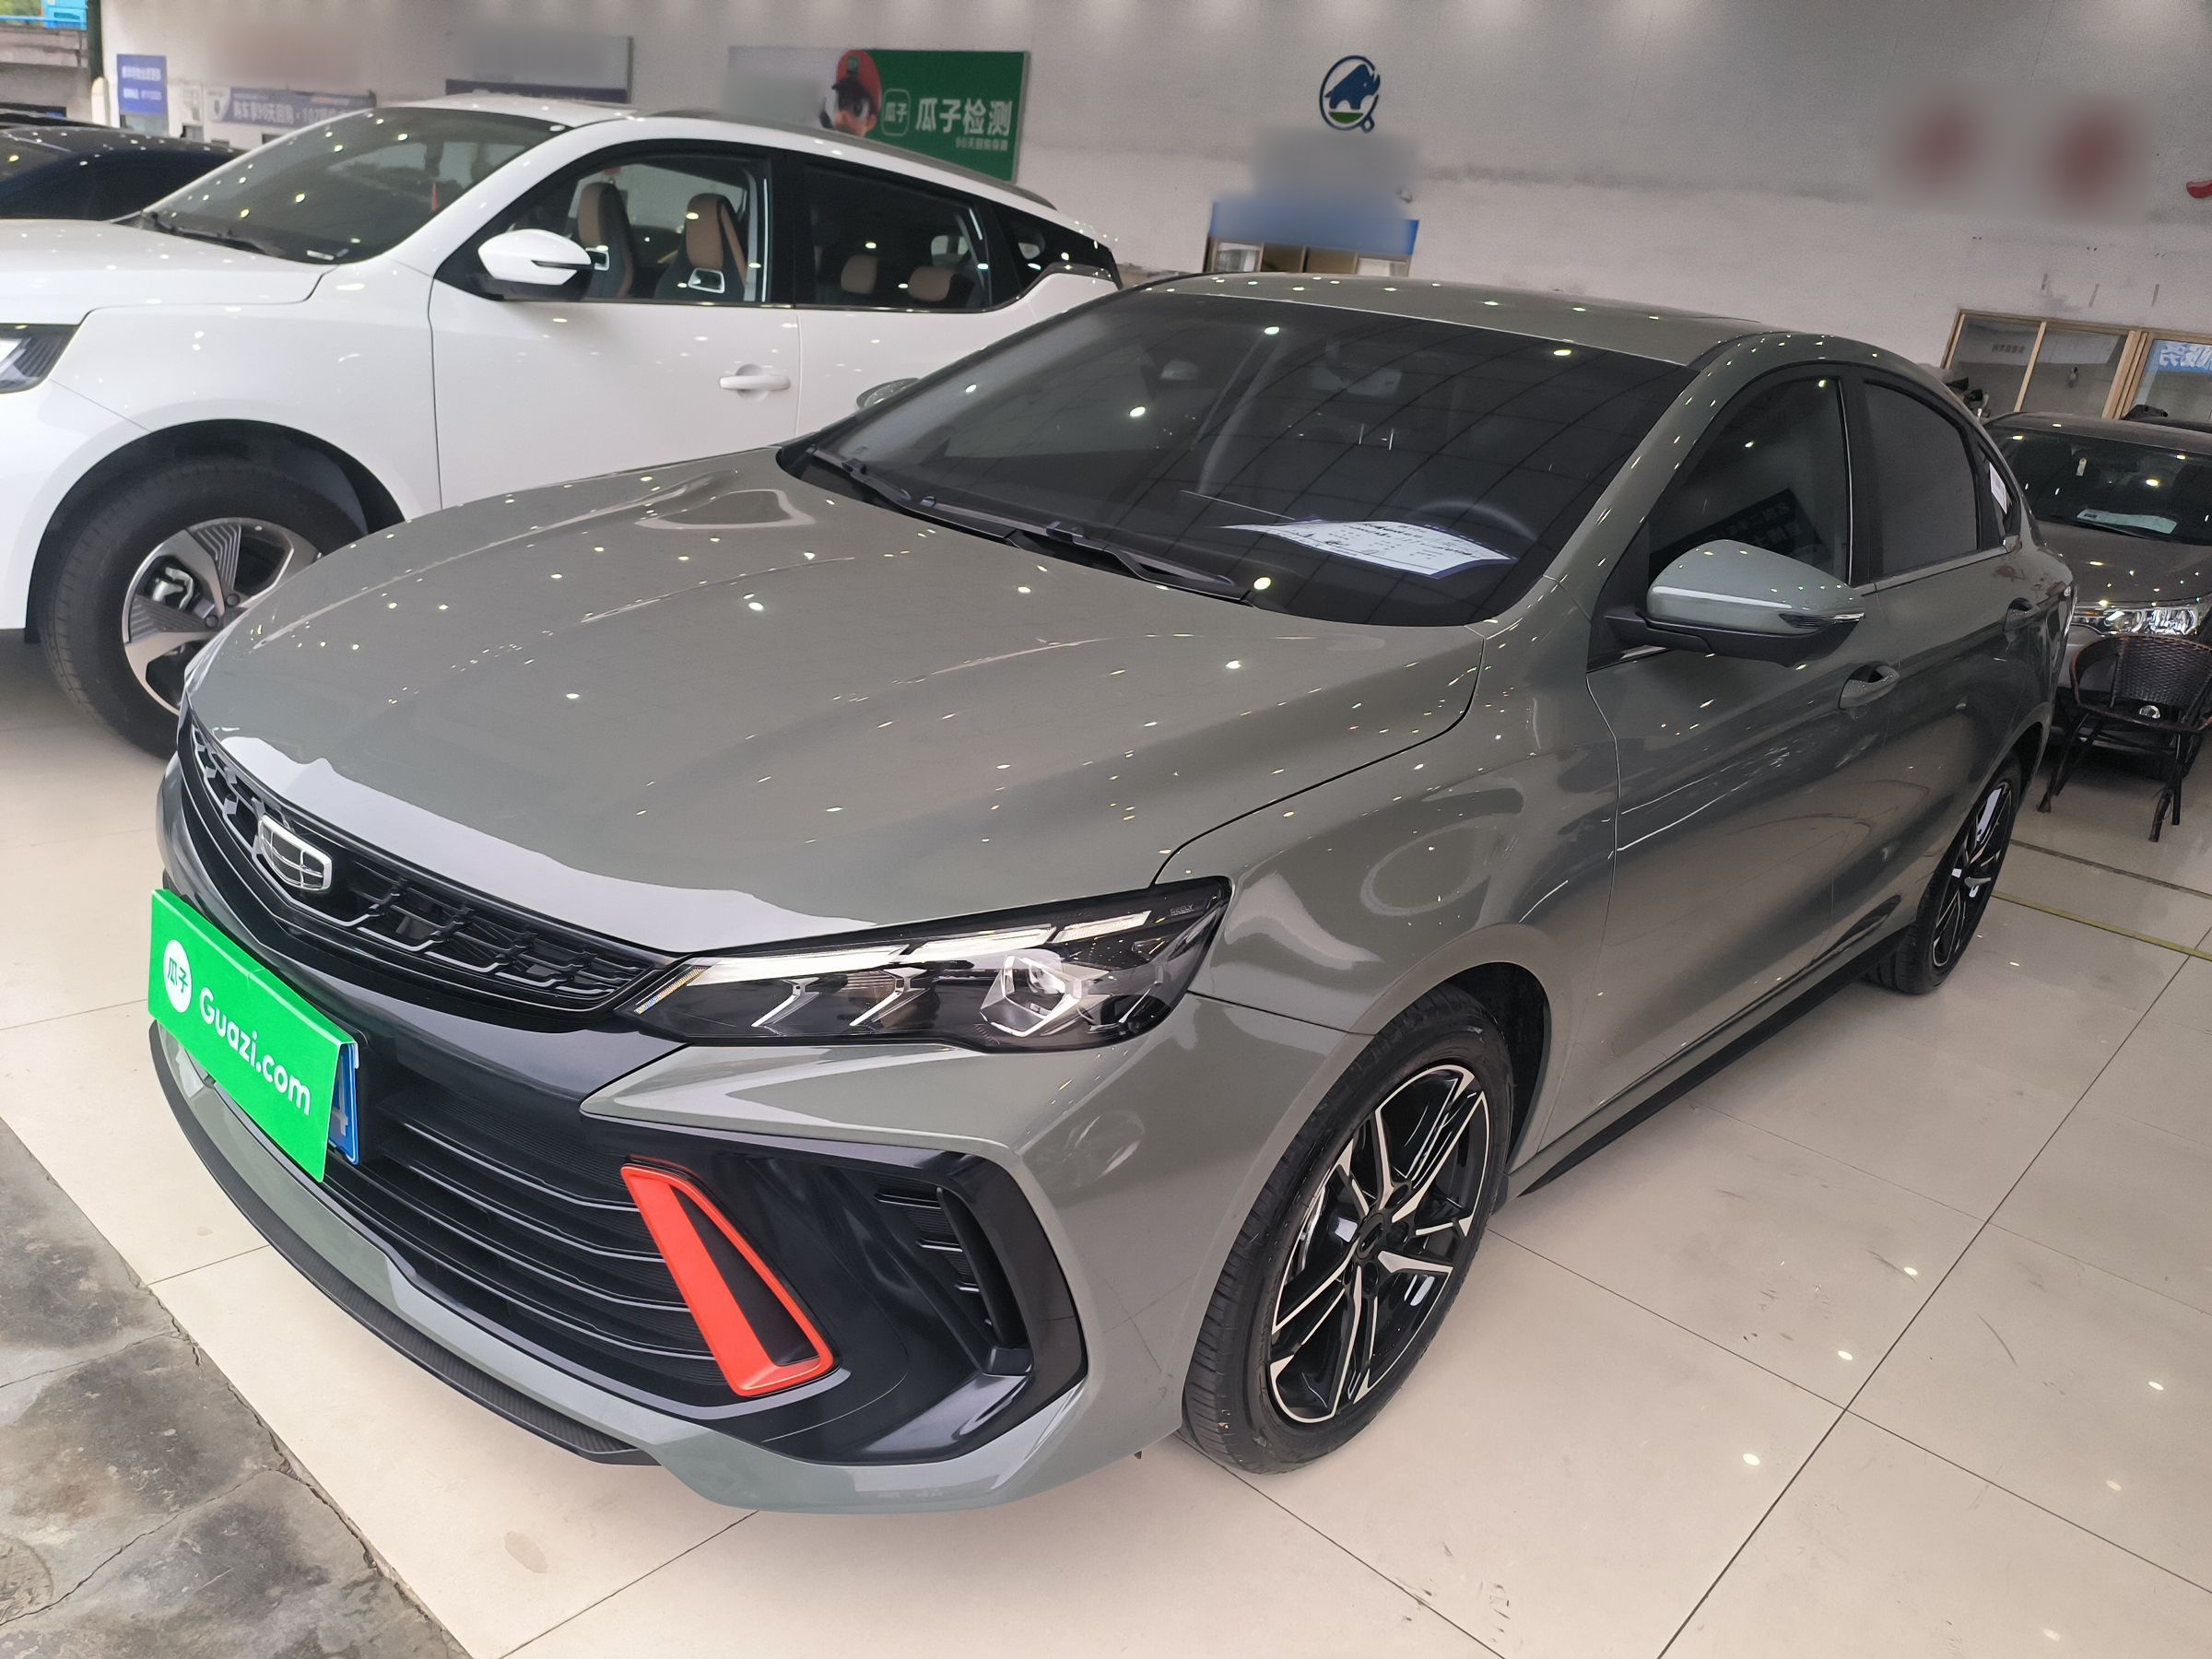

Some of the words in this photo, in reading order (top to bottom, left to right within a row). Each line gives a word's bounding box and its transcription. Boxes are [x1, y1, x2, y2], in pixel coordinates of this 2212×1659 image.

[884, 101, 907, 123] 瓜子
[915, 98, 1013, 136] 瓜子检测
[167, 957, 188, 994] 瓜子
[199, 987, 312, 1116] Guazi.com
